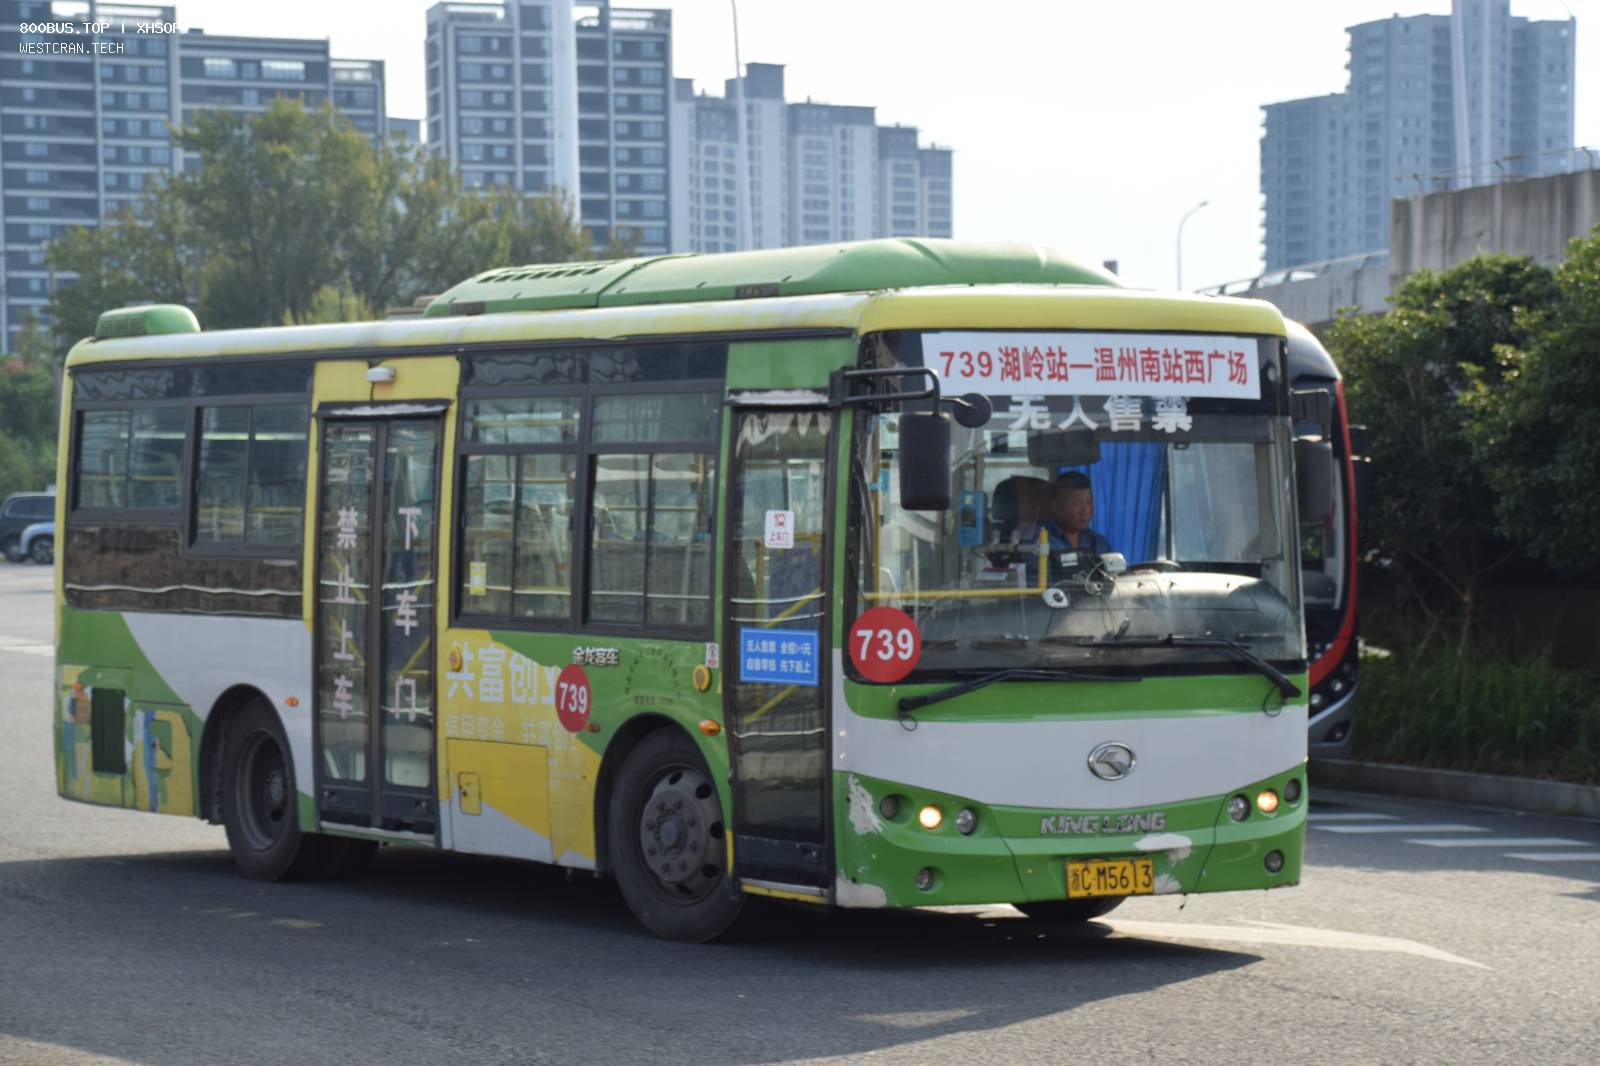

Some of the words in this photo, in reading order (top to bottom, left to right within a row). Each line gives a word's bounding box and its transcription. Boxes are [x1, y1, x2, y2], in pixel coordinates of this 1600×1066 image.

[939, 350, 994, 378] 739
[1008, 394, 1193, 434] 无人售票
[332, 507, 358, 719] 禁止上车
[395, 507, 423, 723] 下车门
[856, 628, 914, 661] 739
[559, 682, 588, 715] 739
[1040, 815, 1099, 835] KING
[1102, 812, 1168, 834] LONG
